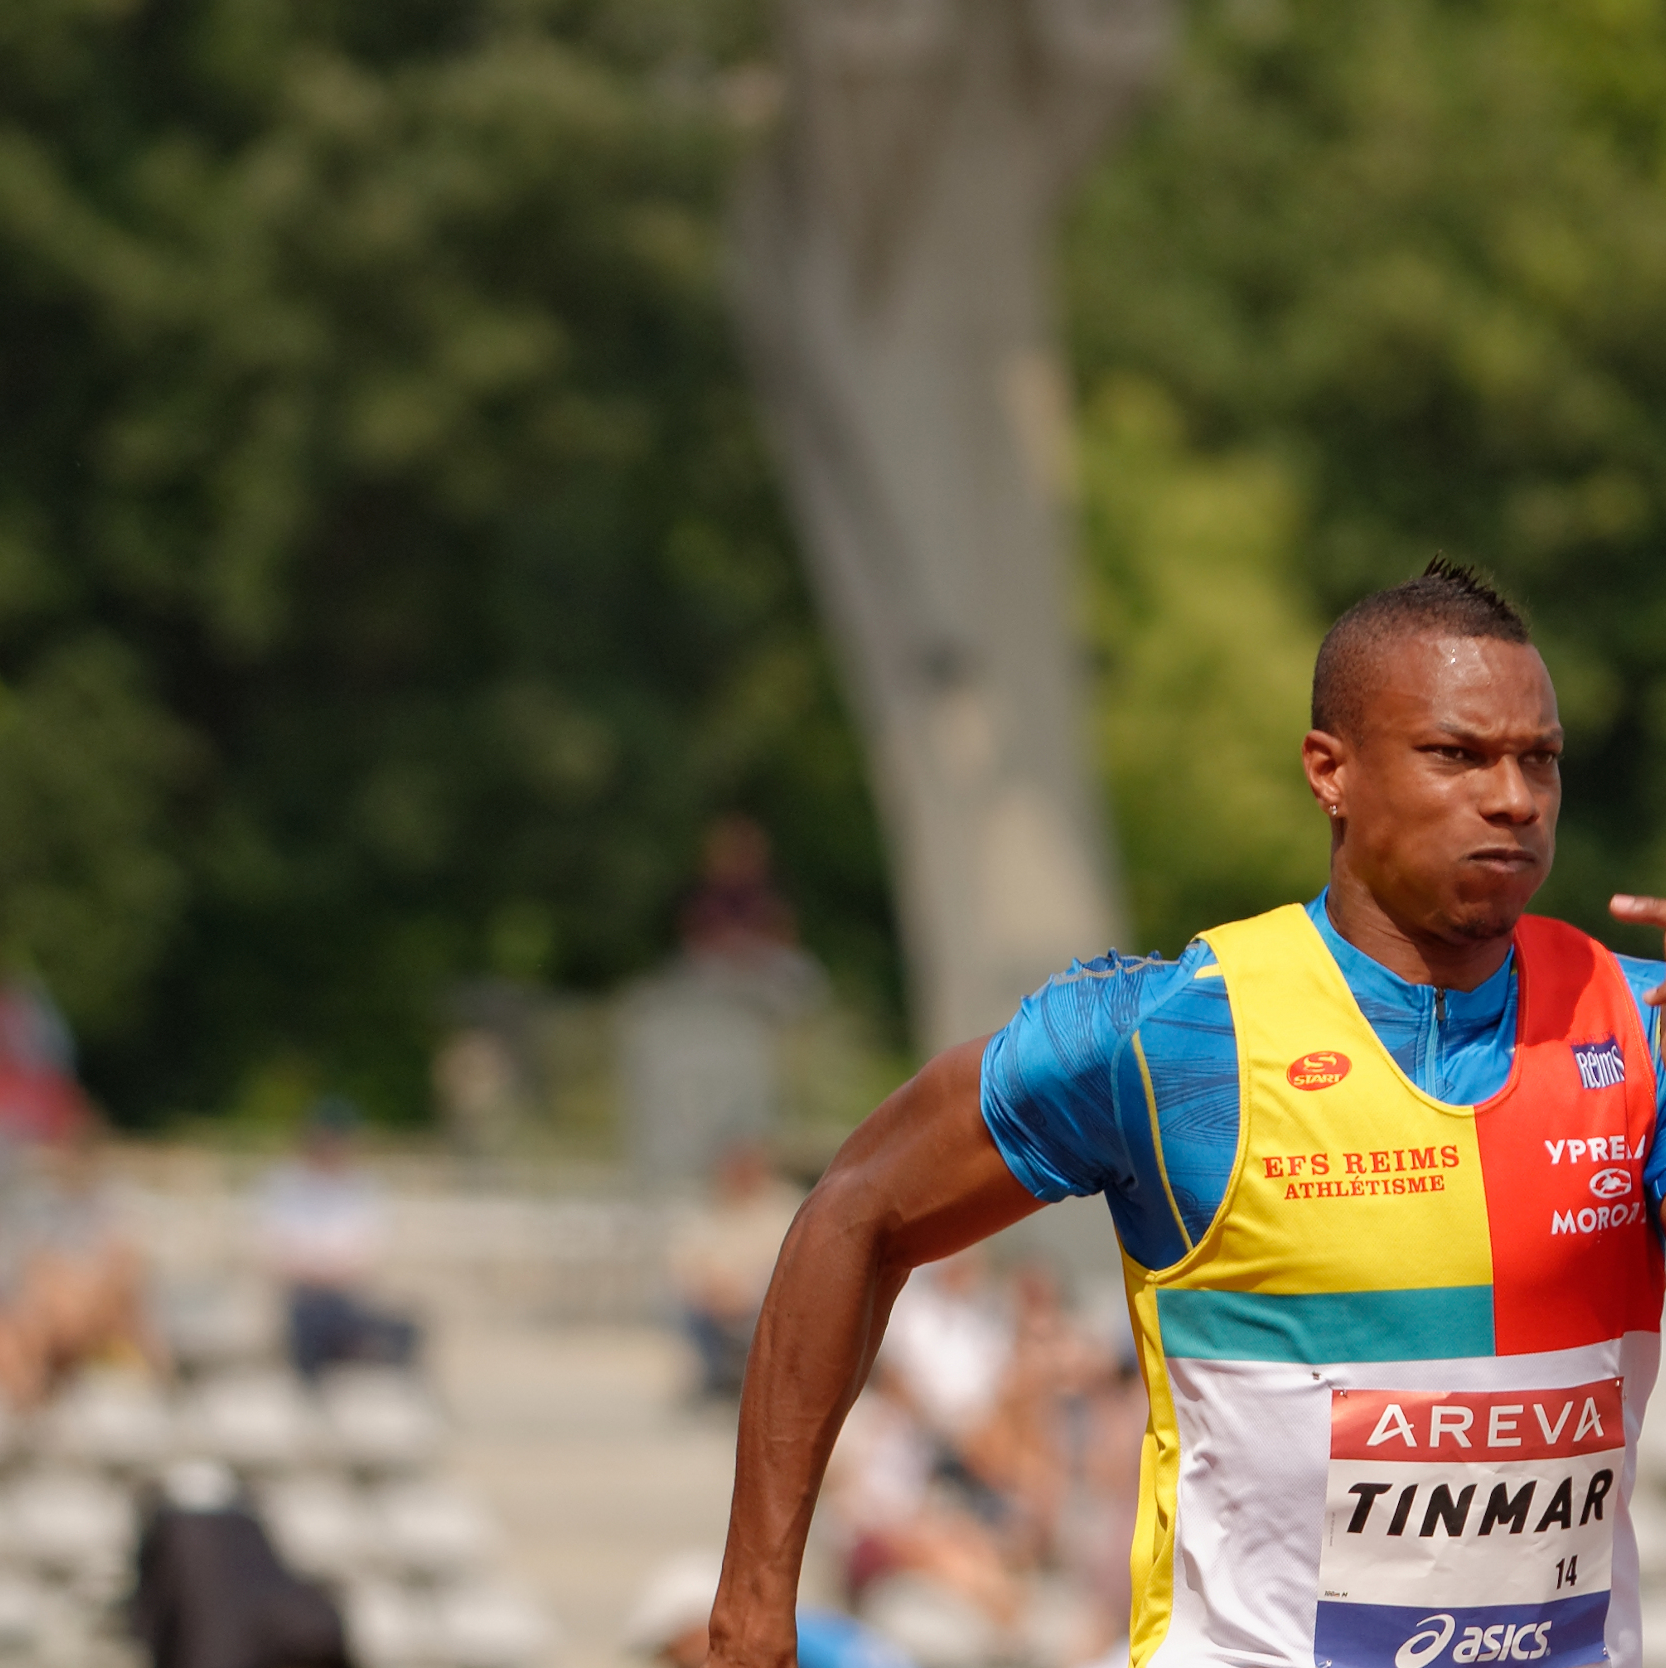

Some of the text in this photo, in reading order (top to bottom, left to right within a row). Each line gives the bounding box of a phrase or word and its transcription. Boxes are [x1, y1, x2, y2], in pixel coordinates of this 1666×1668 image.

[1293, 1073, 1343, 1086] START
[1262, 1144, 1461, 1179] EFS REIMS
[1283, 1174, 1446, 1201] ATHLÉTISME
[1366, 1396, 1606, 1450] AREVA
[1346, 1467, 1614, 1538] TINMAR
[1555, 1555, 1579, 1590] 14
